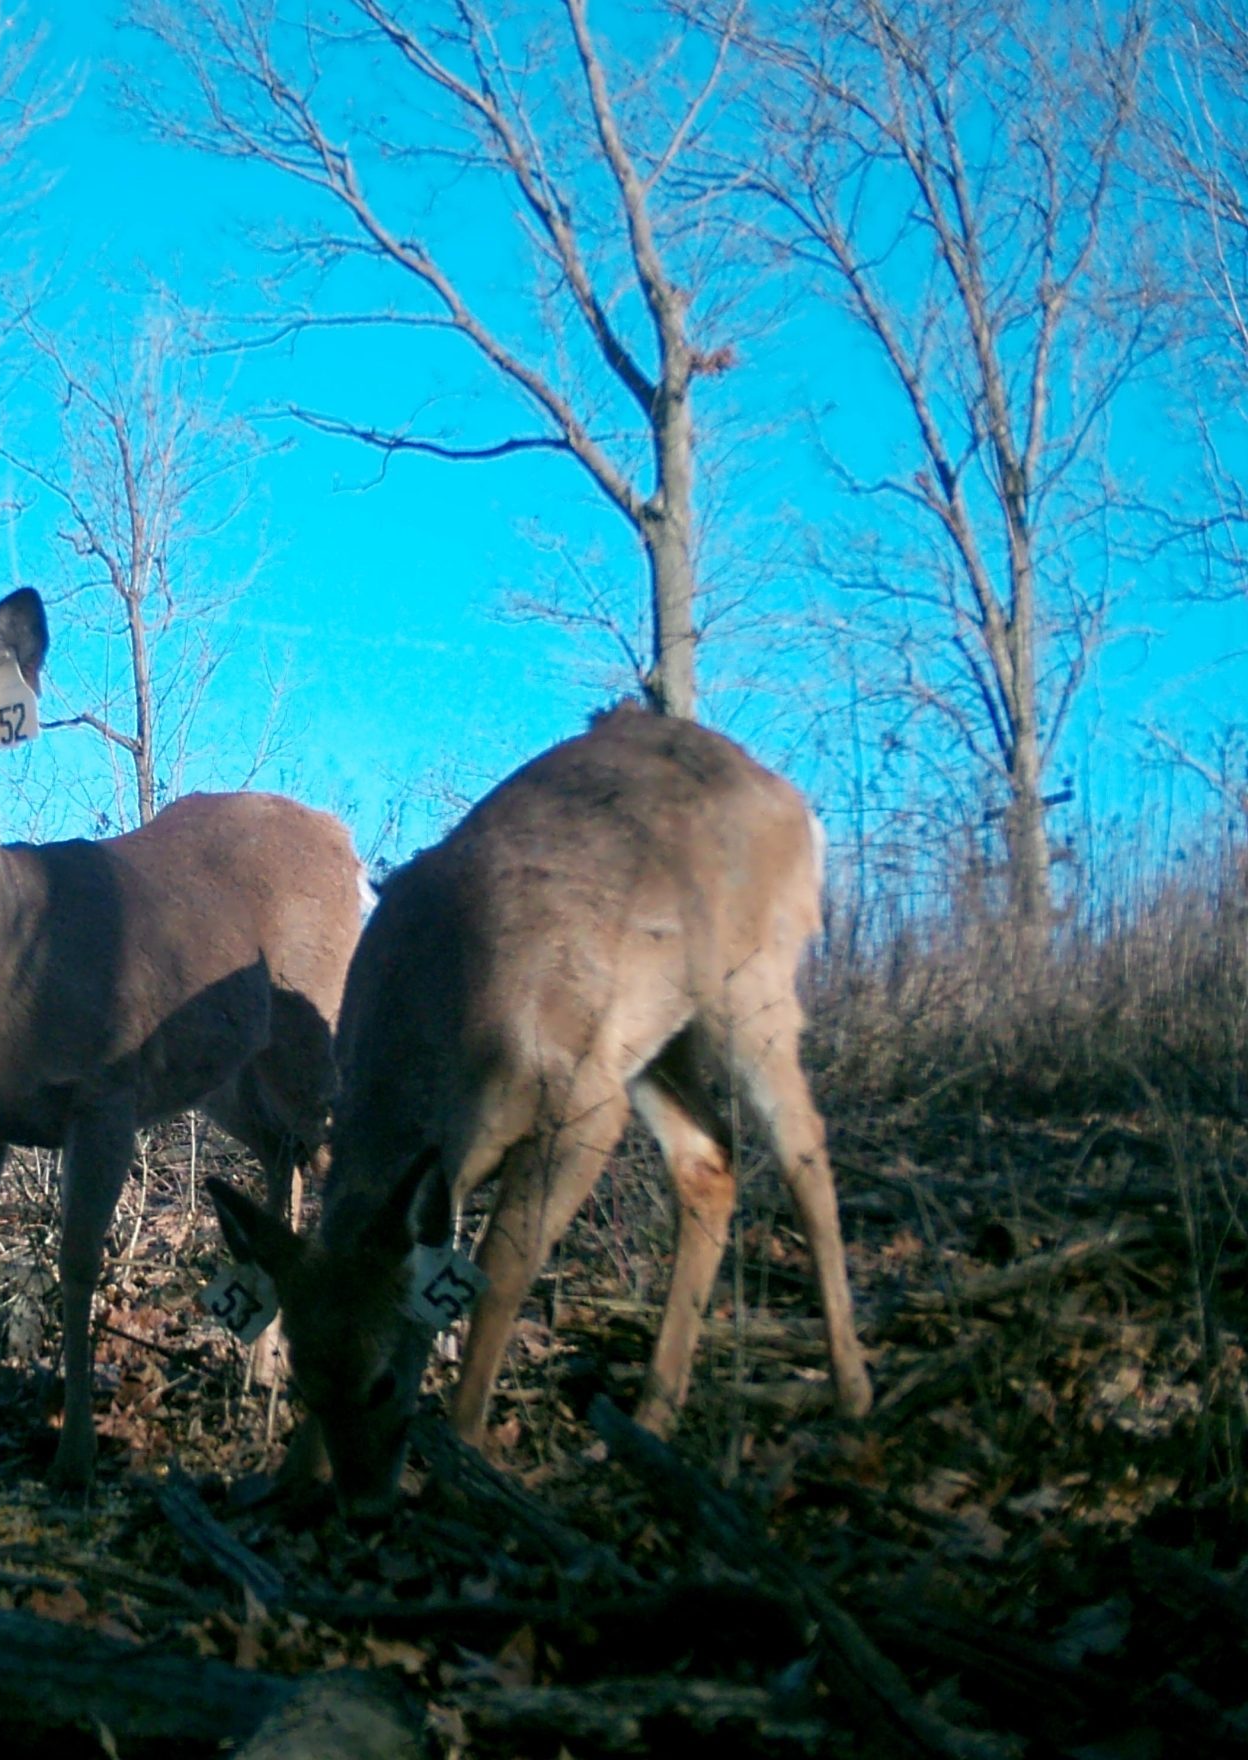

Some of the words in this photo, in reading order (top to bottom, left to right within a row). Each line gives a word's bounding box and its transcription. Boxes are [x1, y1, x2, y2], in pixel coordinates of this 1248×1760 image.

[0, 702, 27, 744] 52
[212, 1282, 263, 1332] 53
[422, 1265, 475, 1319] 53
